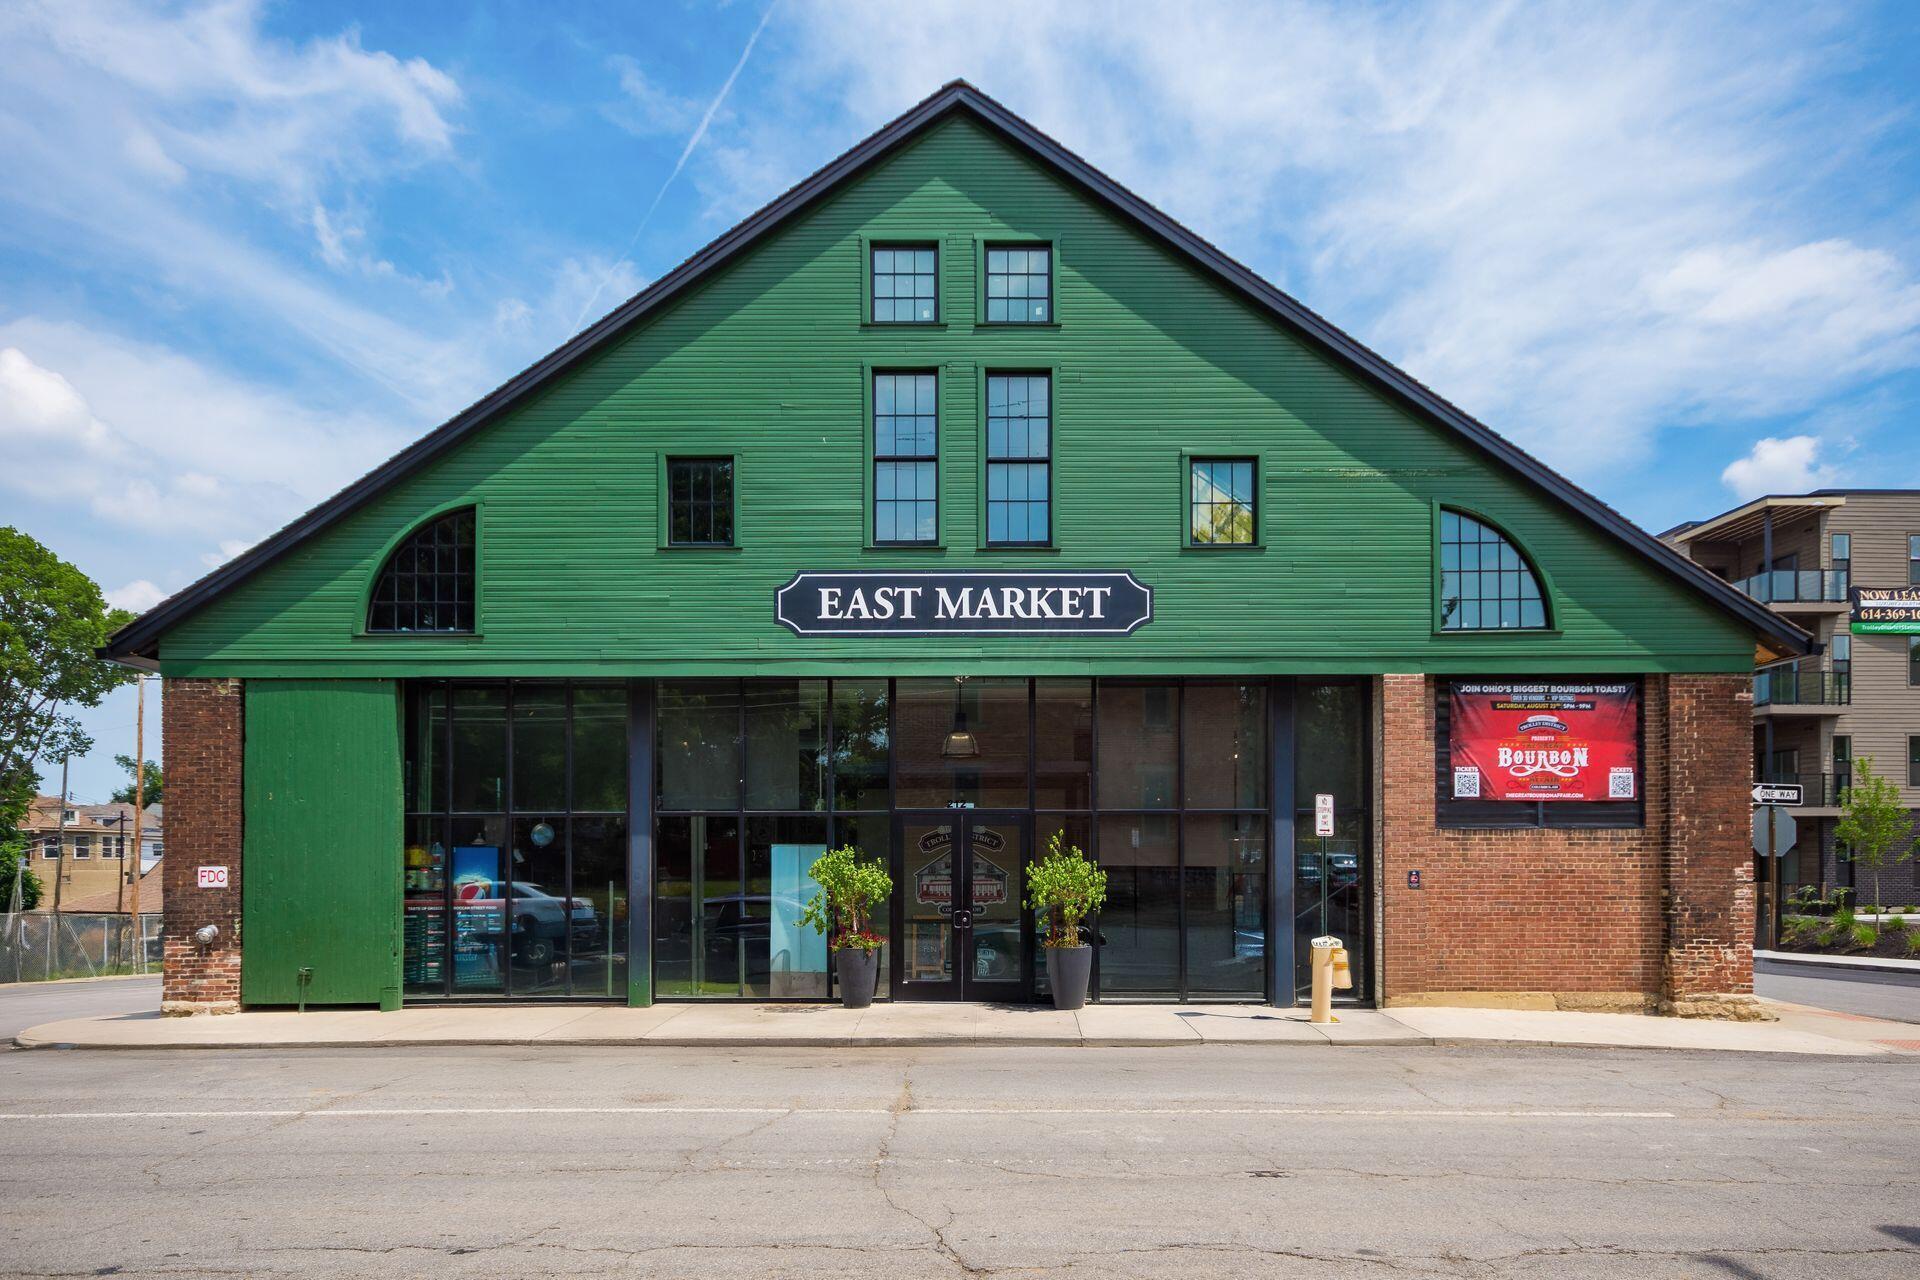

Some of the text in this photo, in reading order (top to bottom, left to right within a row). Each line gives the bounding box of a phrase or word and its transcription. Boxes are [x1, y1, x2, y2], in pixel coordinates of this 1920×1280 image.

[1860, 590, 1891, 600] NOW
[816, 587, 1111, 619] EAST MARKET
[1460, 685, 1626, 693] JOIN OHIO'S BIGGEST BOURBON TOAST!
[1497, 747, 1589, 772] BOURBON
[1760, 790, 1776, 798] ONE
[926, 834, 951, 848] TROLL
[200, 870, 226, 883] FDC
